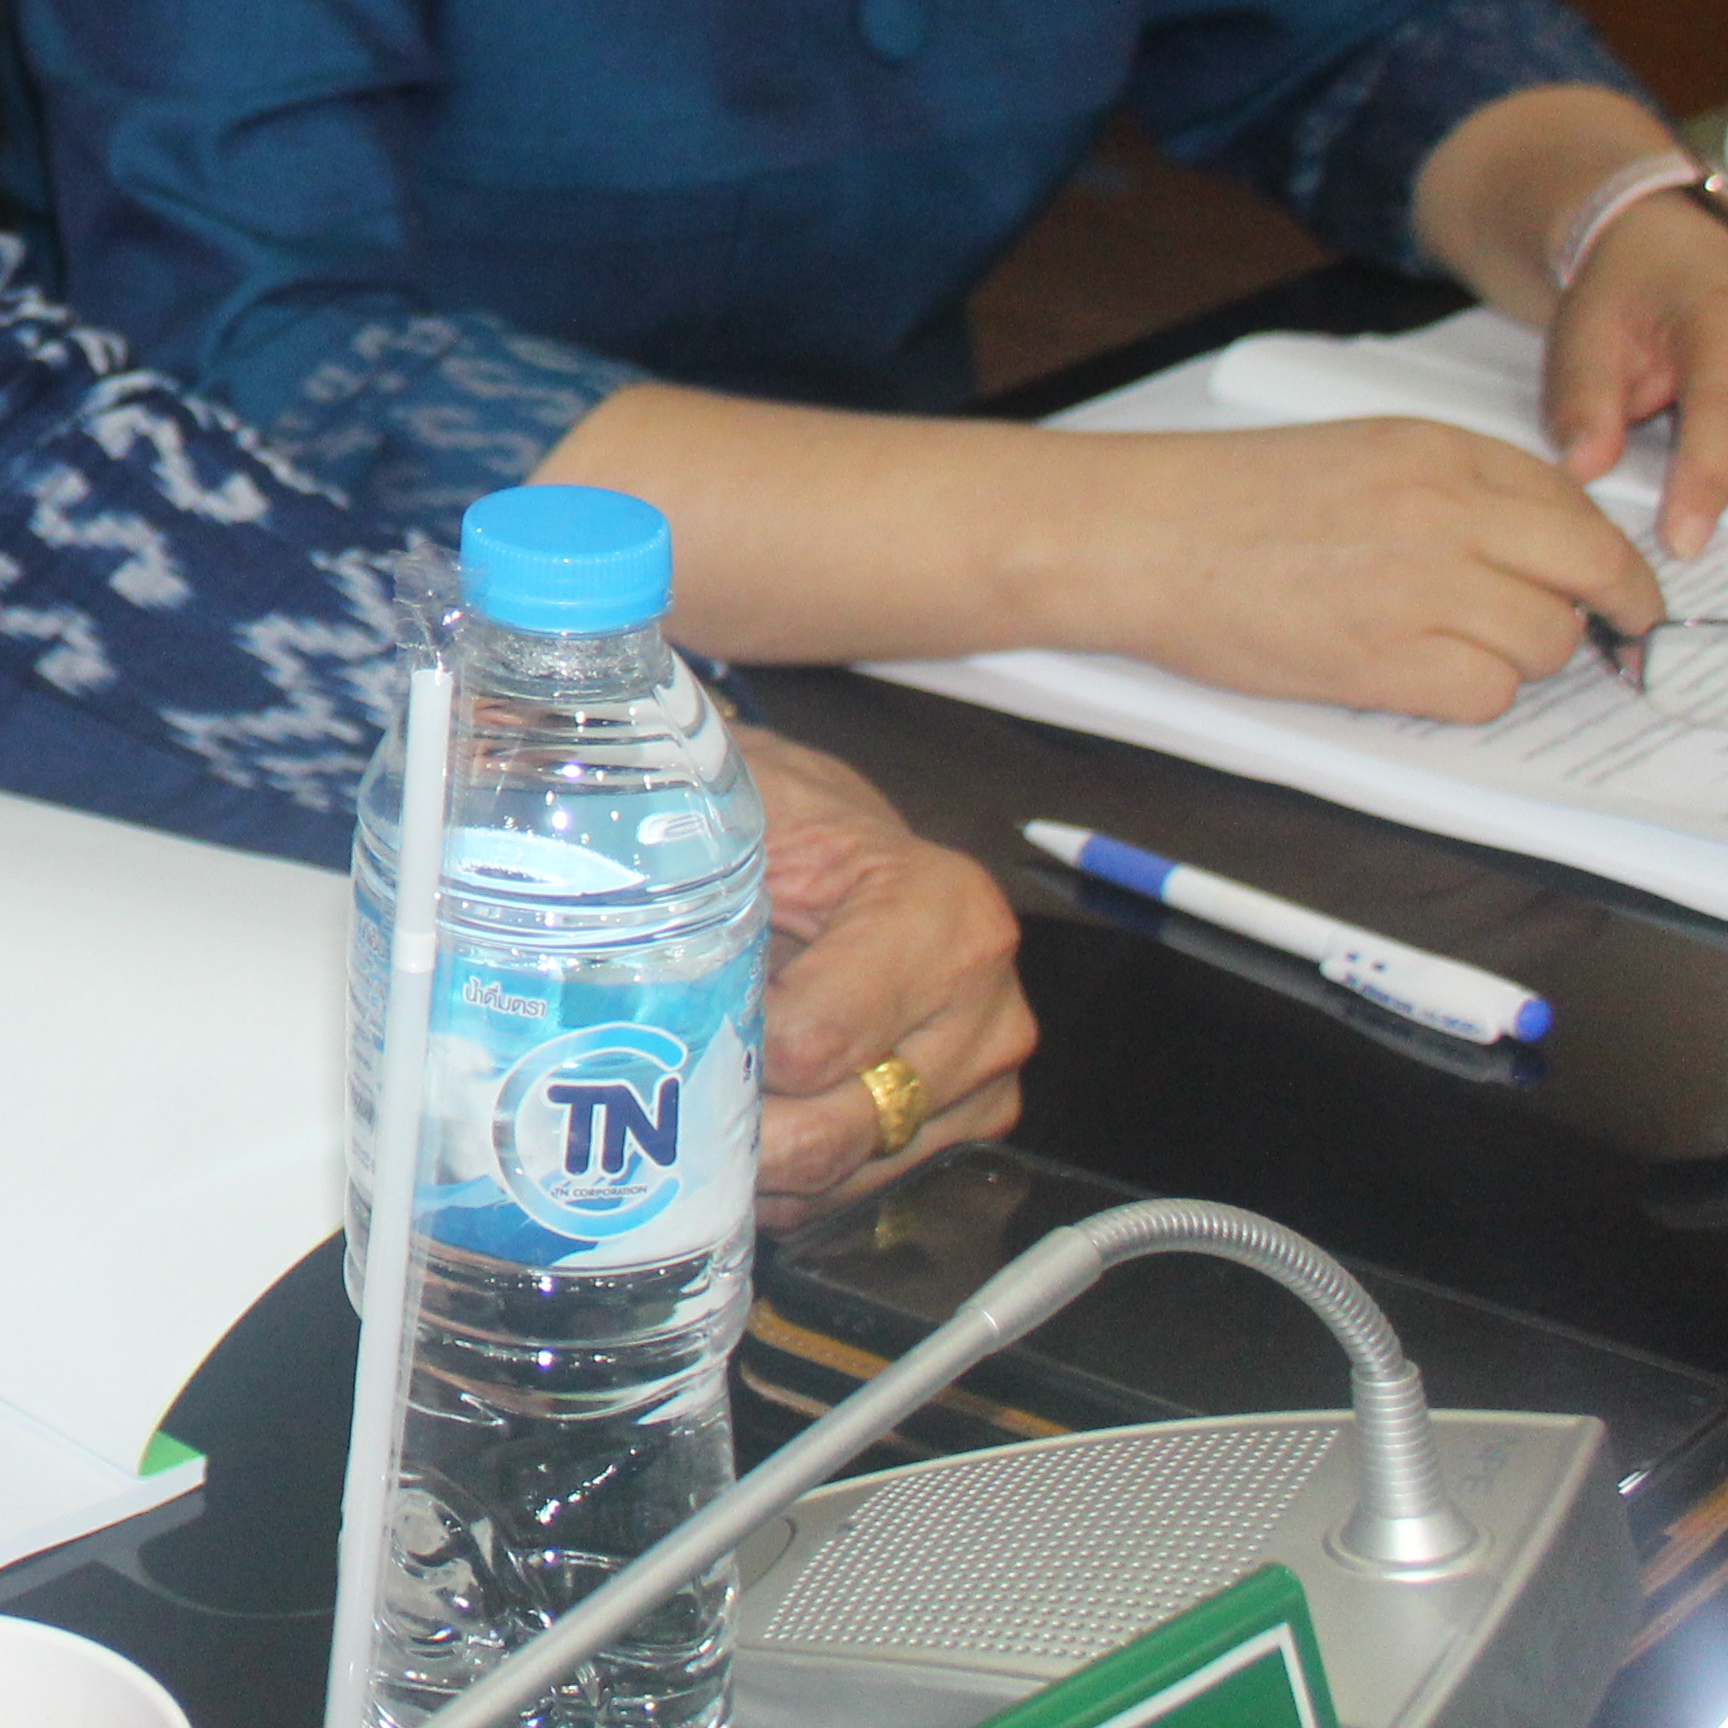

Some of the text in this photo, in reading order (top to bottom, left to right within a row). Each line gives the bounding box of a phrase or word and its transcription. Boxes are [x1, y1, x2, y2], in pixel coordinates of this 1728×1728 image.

[464, 977, 547, 1018] น้ำดื่มตรา
[547, 1076, 680, 1175] TN
[572, 1184, 647, 1198] CORPORATION
